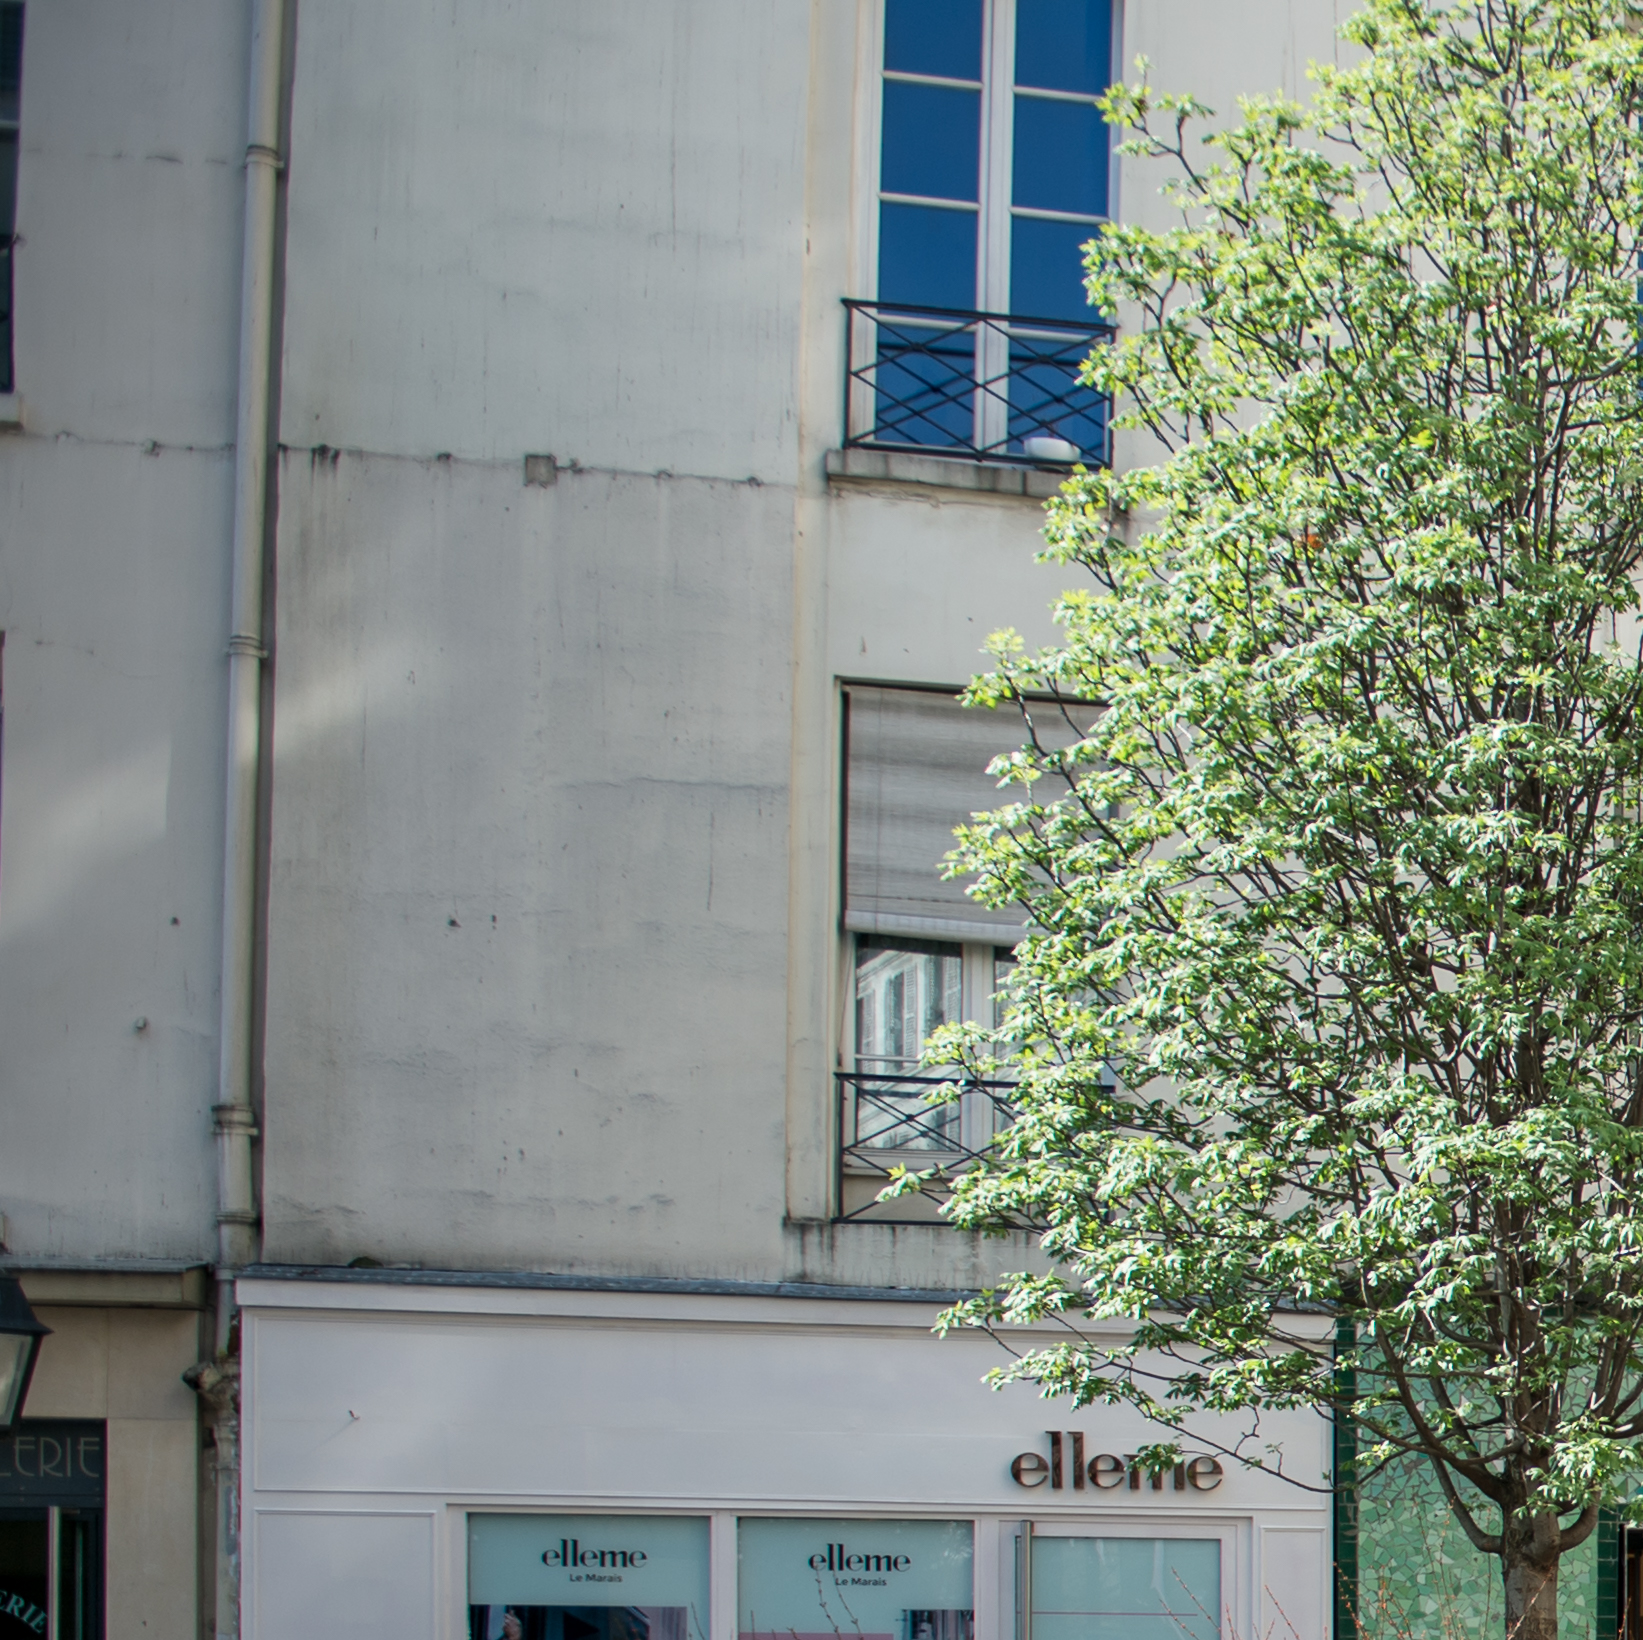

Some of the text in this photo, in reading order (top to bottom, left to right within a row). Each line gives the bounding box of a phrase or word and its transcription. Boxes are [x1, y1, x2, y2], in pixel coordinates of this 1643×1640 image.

[0, 1437, 100, 1477] ERIE
[541, 1538, 648, 1568] elleme
[808, 1543, 911, 1572] elleme
[569, 1574, 623, 1582] Le Marais
[836, 1578, 887, 1586] Le Marais
